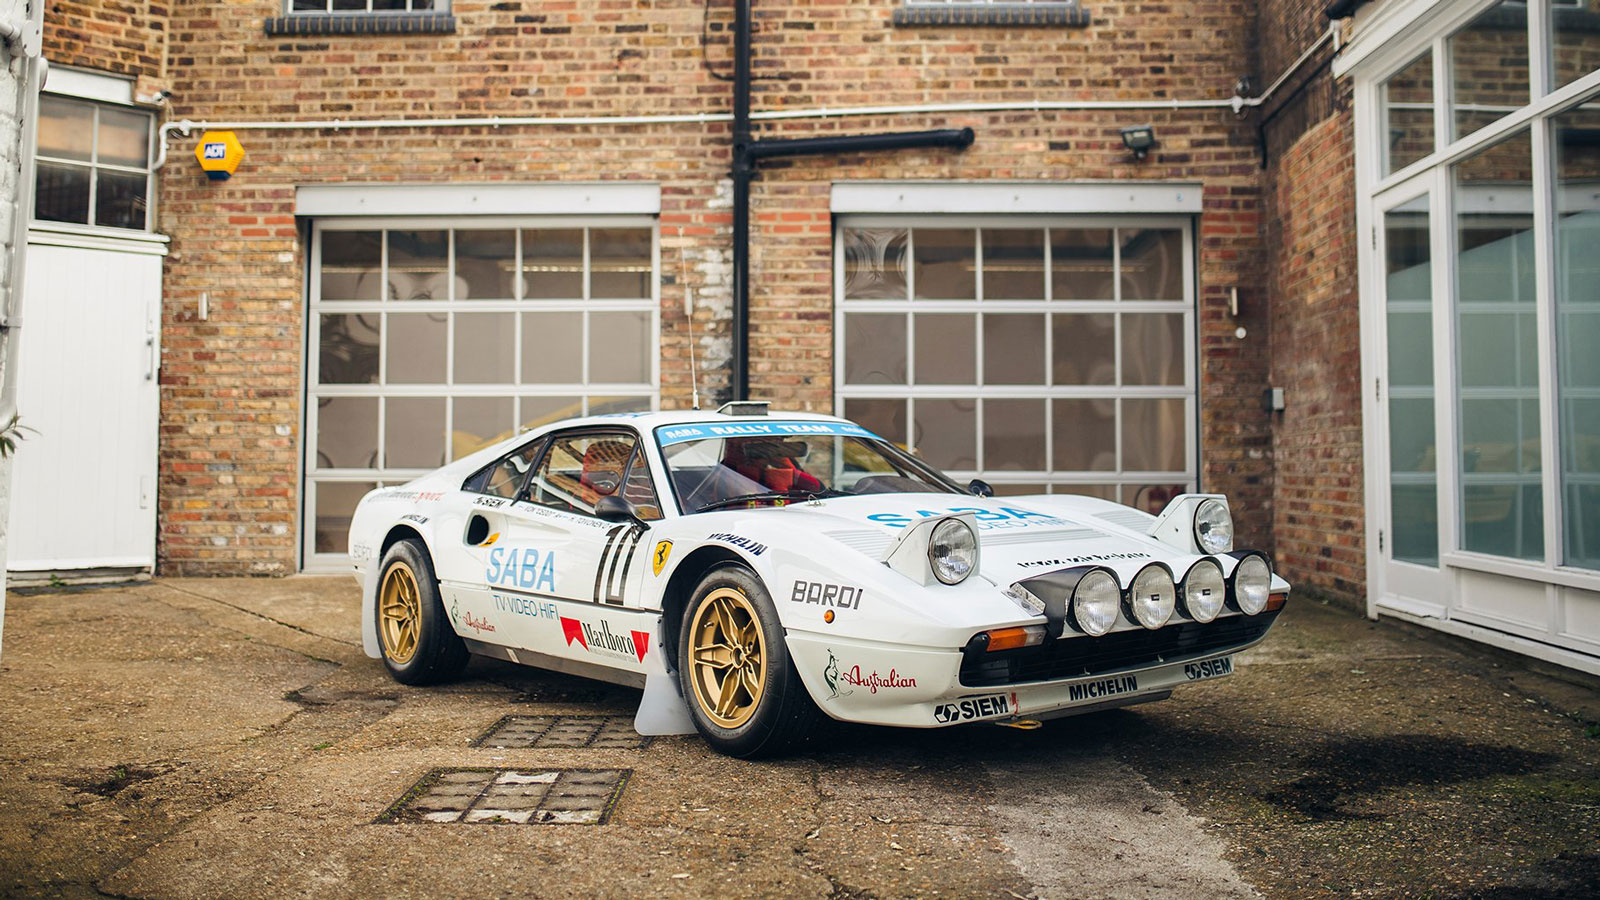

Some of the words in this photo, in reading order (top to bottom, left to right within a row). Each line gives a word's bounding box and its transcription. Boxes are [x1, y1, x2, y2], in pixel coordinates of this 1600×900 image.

[710, 424, 773, 435] RALLY
[776, 424, 834, 433] TEAM
[706, 533, 768, 556] MICHELIN
[486, 547, 555, 592] SABA
[791, 580, 863, 610] BARDI
[582, 620, 635, 655] Marlboro
[842, 665, 917, 694] Australian
[1202, 657, 1232, 678] SIEM
[1068, 676, 1138, 701] MICHELIN
[961, 695, 1009, 719] SIEM
